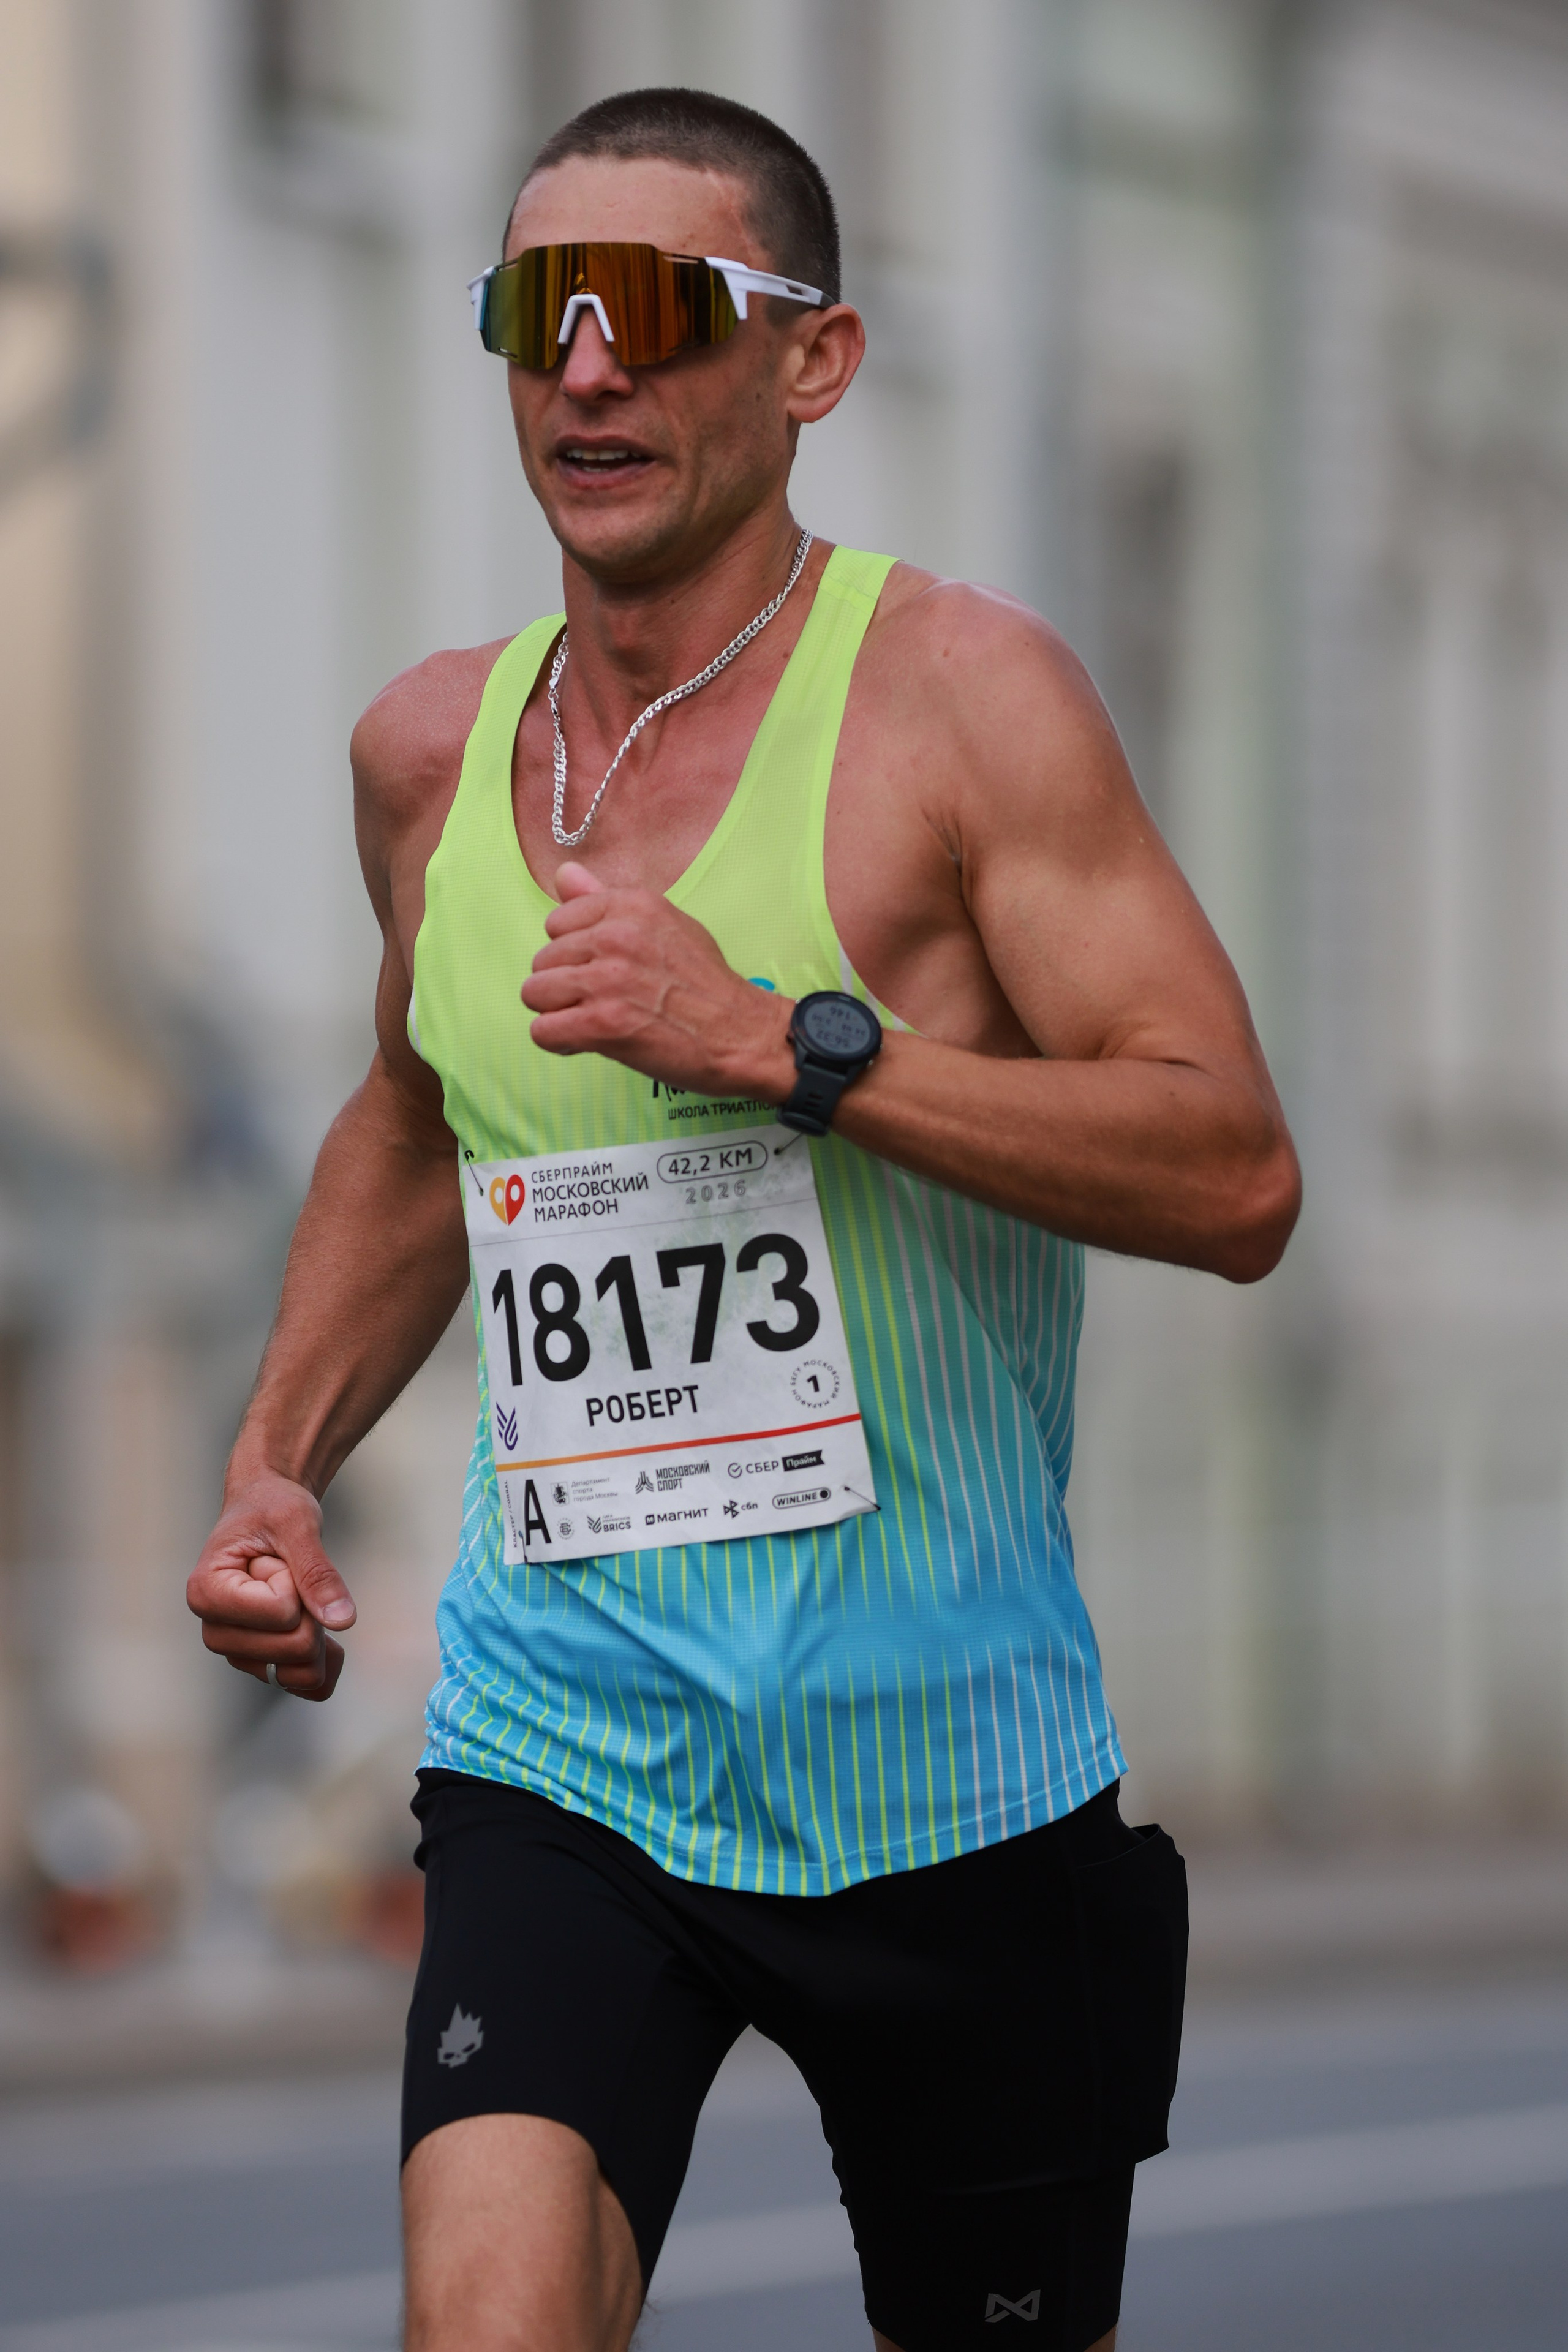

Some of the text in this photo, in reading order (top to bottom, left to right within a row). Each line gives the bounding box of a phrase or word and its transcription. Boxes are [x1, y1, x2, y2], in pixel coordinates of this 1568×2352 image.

[668, 1105, 709, 1120] ШКОЛА
[530, 1162, 613, 1183] СБЕРПРАЙМ
[668, 1154, 710, 1176] 42,2
[532, 1172, 649, 1204] МОСКОВСКИЙ
[685, 1179, 747, 1205] 2026
[534, 1199, 619, 1223] МАРАФОН
[492, 1232, 820, 1387] 18173
[806, 1374, 820, 1392] 1
[586, 1385, 699, 1427] РОБЕРТ
[655, 1460, 710, 1479] МОСКОВСКИЙ
[745, 1455, 817, 1474] СБЕР Прайм
[571, 1477, 610, 1488] Департамент
[657, 1478, 682, 1492] СПОРТ
[595, 1491, 618, 1500] Москвы
[777, 1493, 817, 1506] WINLINE
[657, 1507, 709, 1523] магнит
[741, 1502, 758, 1512] сбп
[603, 1521, 631, 1532] BRICS
